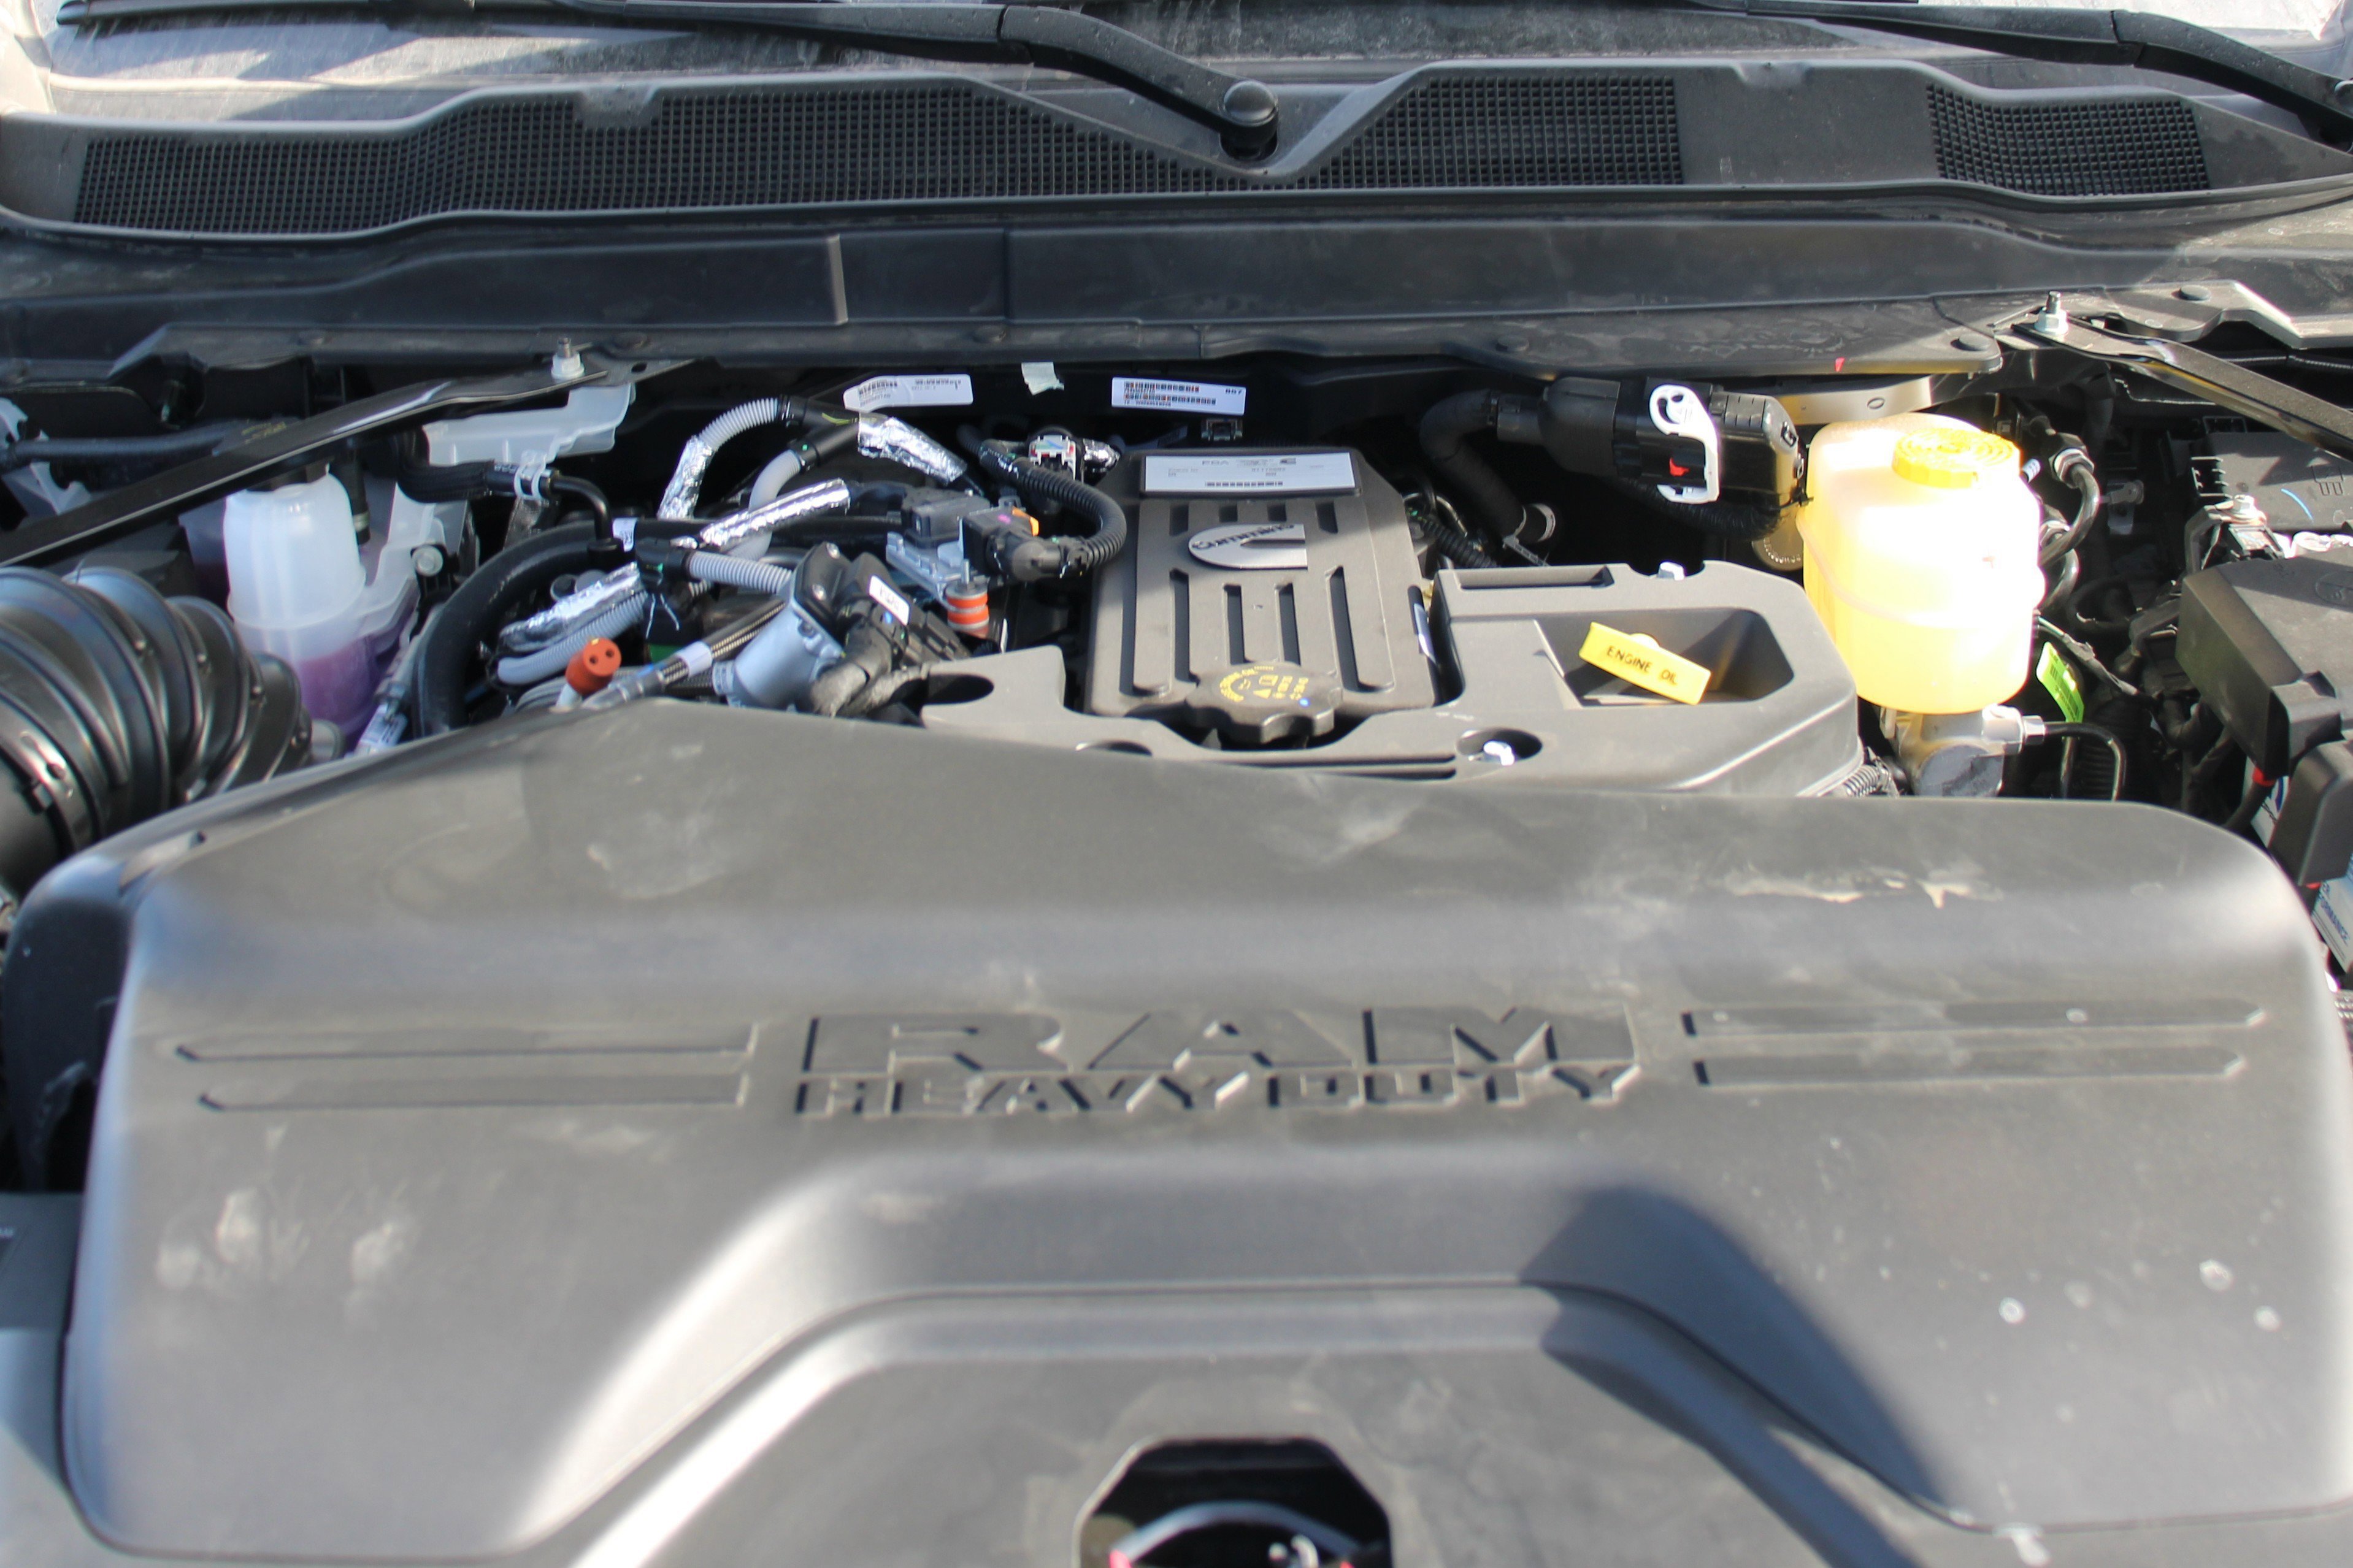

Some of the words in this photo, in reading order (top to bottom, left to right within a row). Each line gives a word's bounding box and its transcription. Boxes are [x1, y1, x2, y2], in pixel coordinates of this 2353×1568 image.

[1606, 645, 1651, 672] ENGINE
[1660, 668, 1676, 685] OIL
[801, 1007, 1639, 1073] RAM
[796, 1072, 1248, 1115] HEAVY
[1265, 1064, 1641, 1107] DUTY
